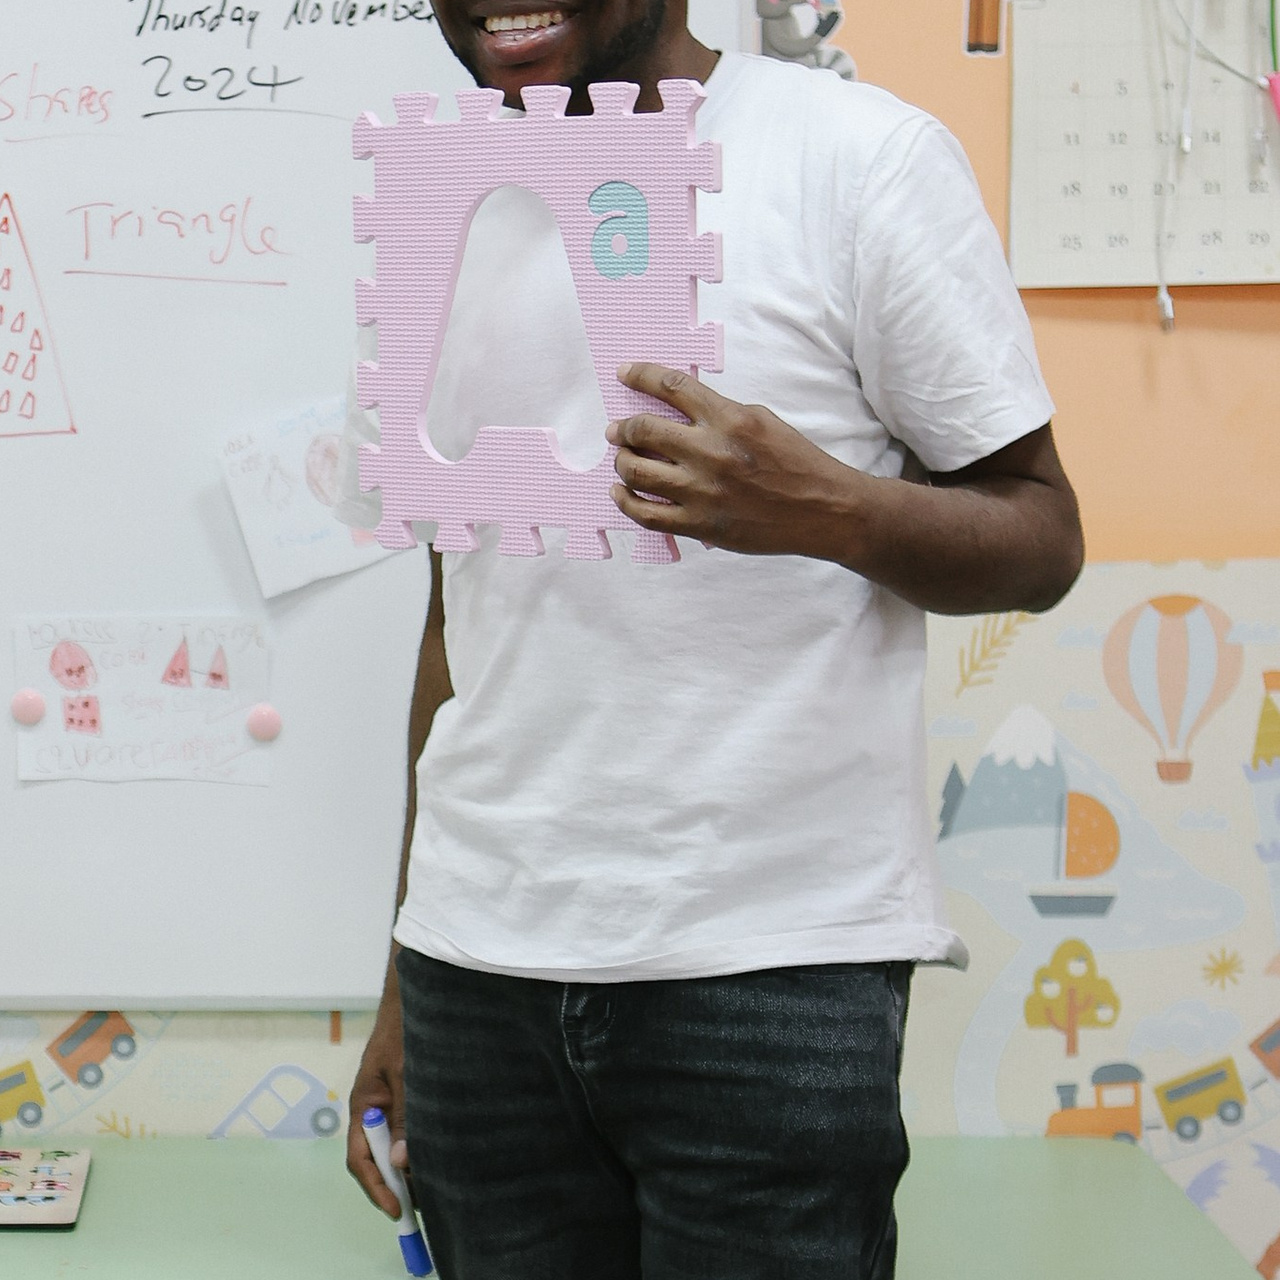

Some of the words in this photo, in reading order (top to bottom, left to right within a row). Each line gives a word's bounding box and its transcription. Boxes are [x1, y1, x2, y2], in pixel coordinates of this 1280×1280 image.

[141, 55, 305, 103] 2024
[67, 197, 289, 265] Triangle
[417, 182, 610, 472] A
[587, 180, 650, 281] a
